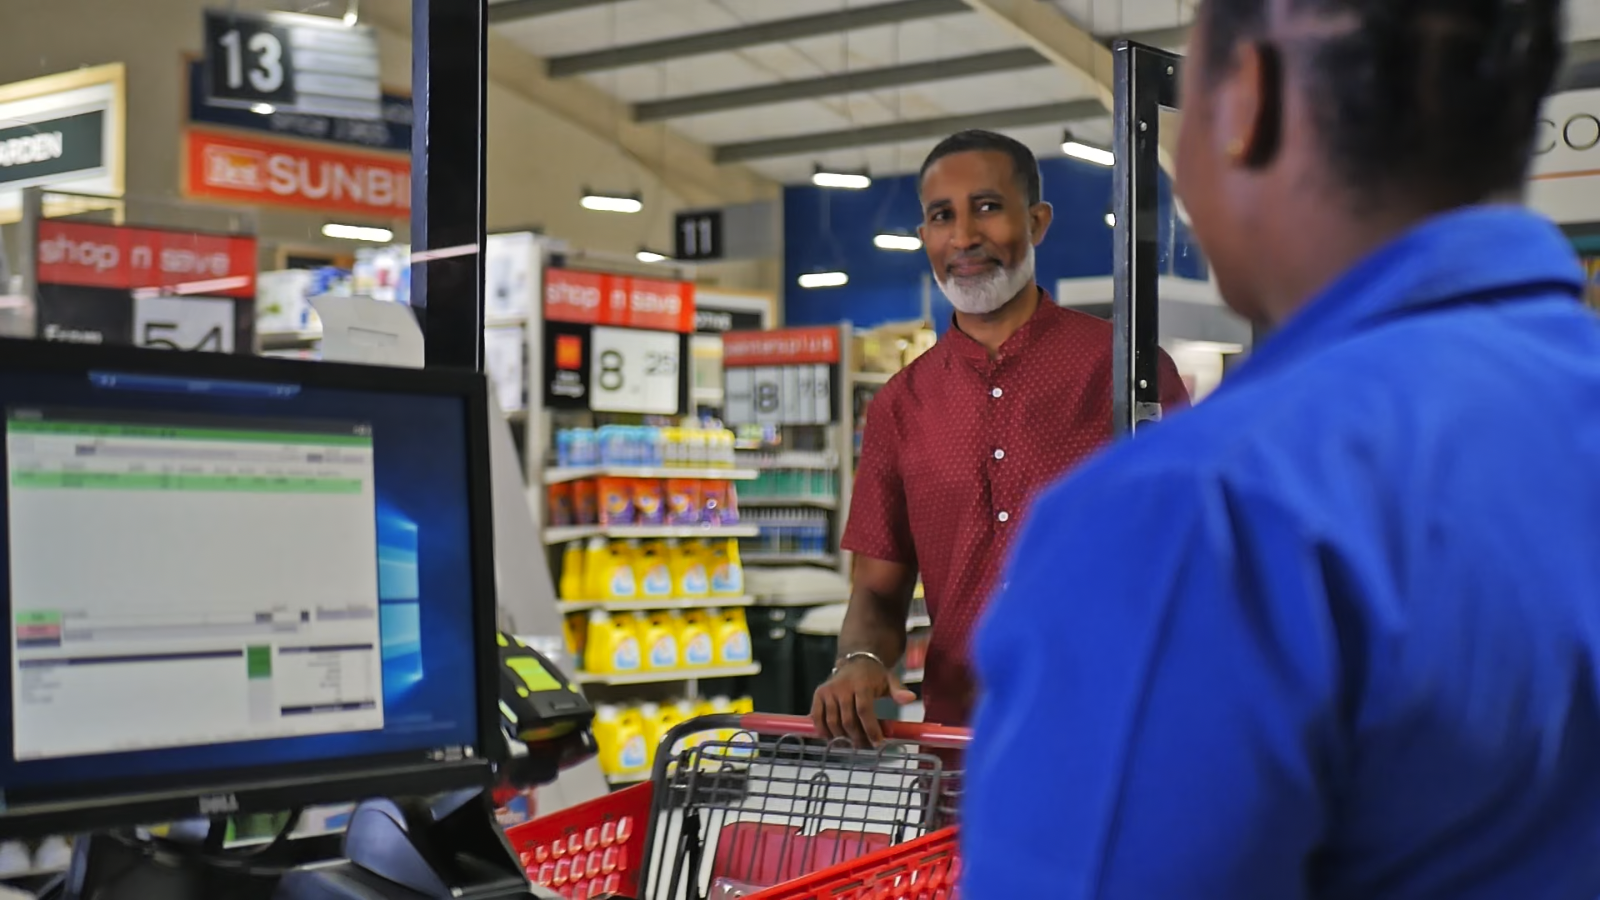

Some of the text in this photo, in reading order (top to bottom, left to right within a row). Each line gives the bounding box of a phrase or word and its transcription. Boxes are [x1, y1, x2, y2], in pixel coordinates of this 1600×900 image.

[219, 29, 285, 93] 13
[40, 234, 230, 276] shop n save
[680, 217, 712, 256] 11
[546, 281, 601, 311] shop
[630, 290, 682, 315] save
[600, 350, 624, 391] 8
